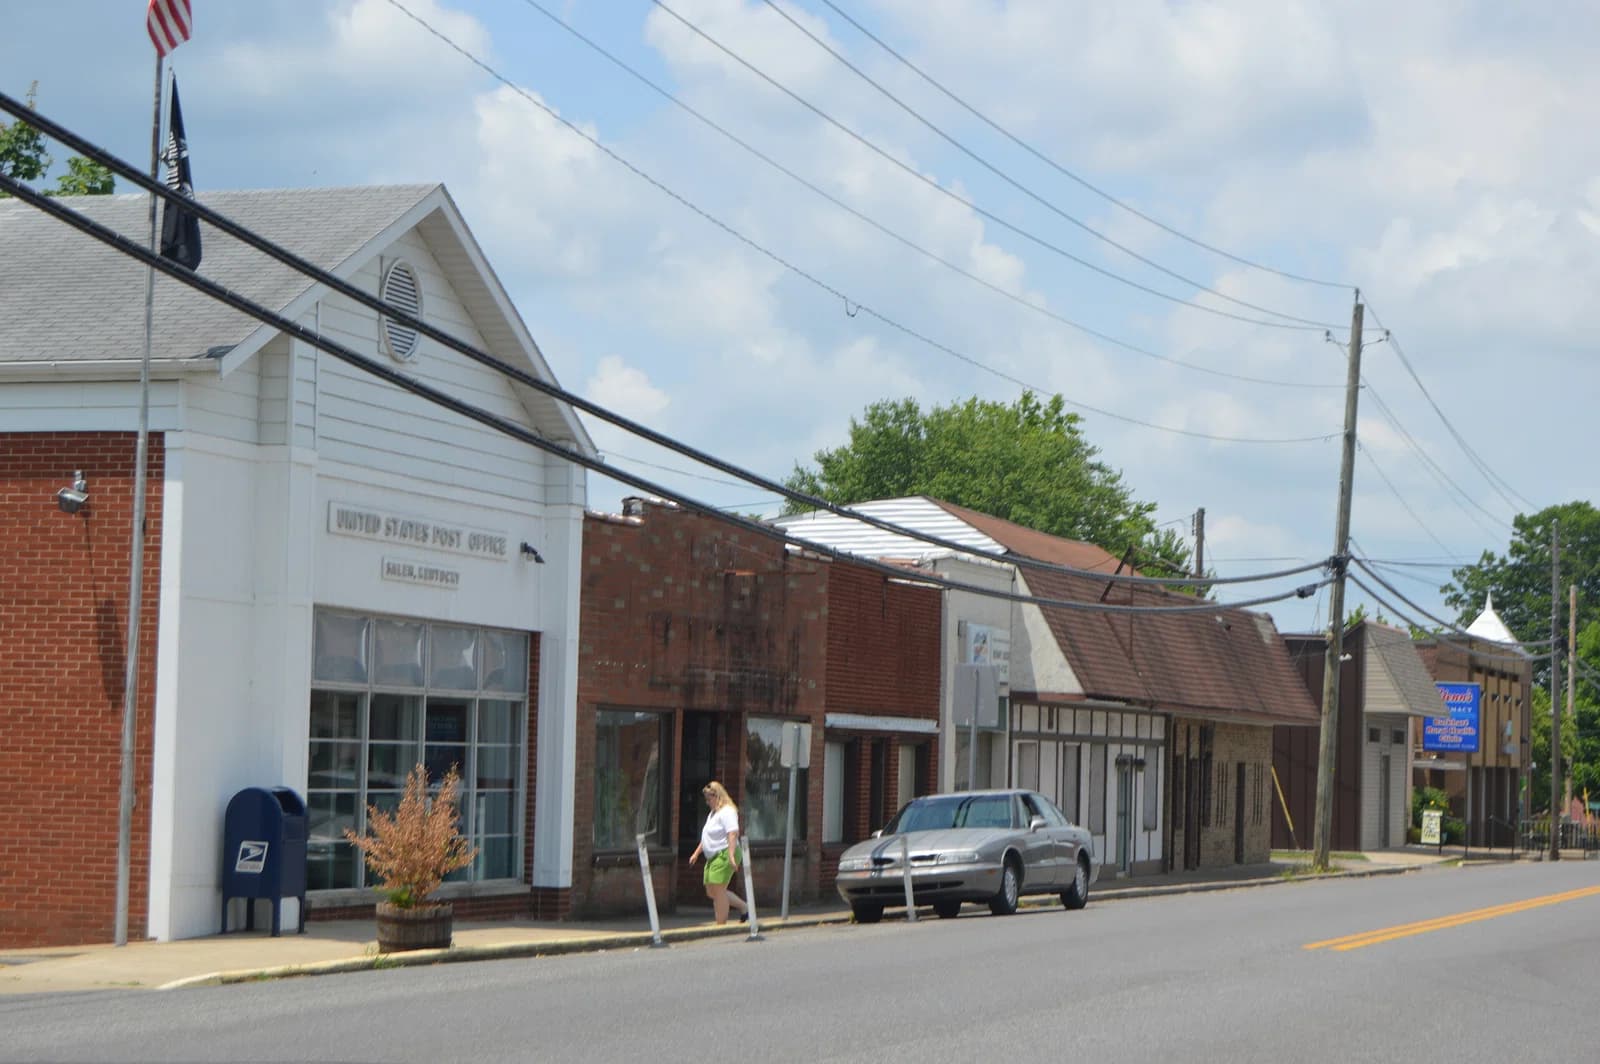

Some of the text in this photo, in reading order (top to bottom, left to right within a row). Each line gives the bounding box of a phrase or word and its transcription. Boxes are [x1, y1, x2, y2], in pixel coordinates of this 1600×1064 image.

[337, 508, 507, 556] UNITED STATES POST OFFICE
